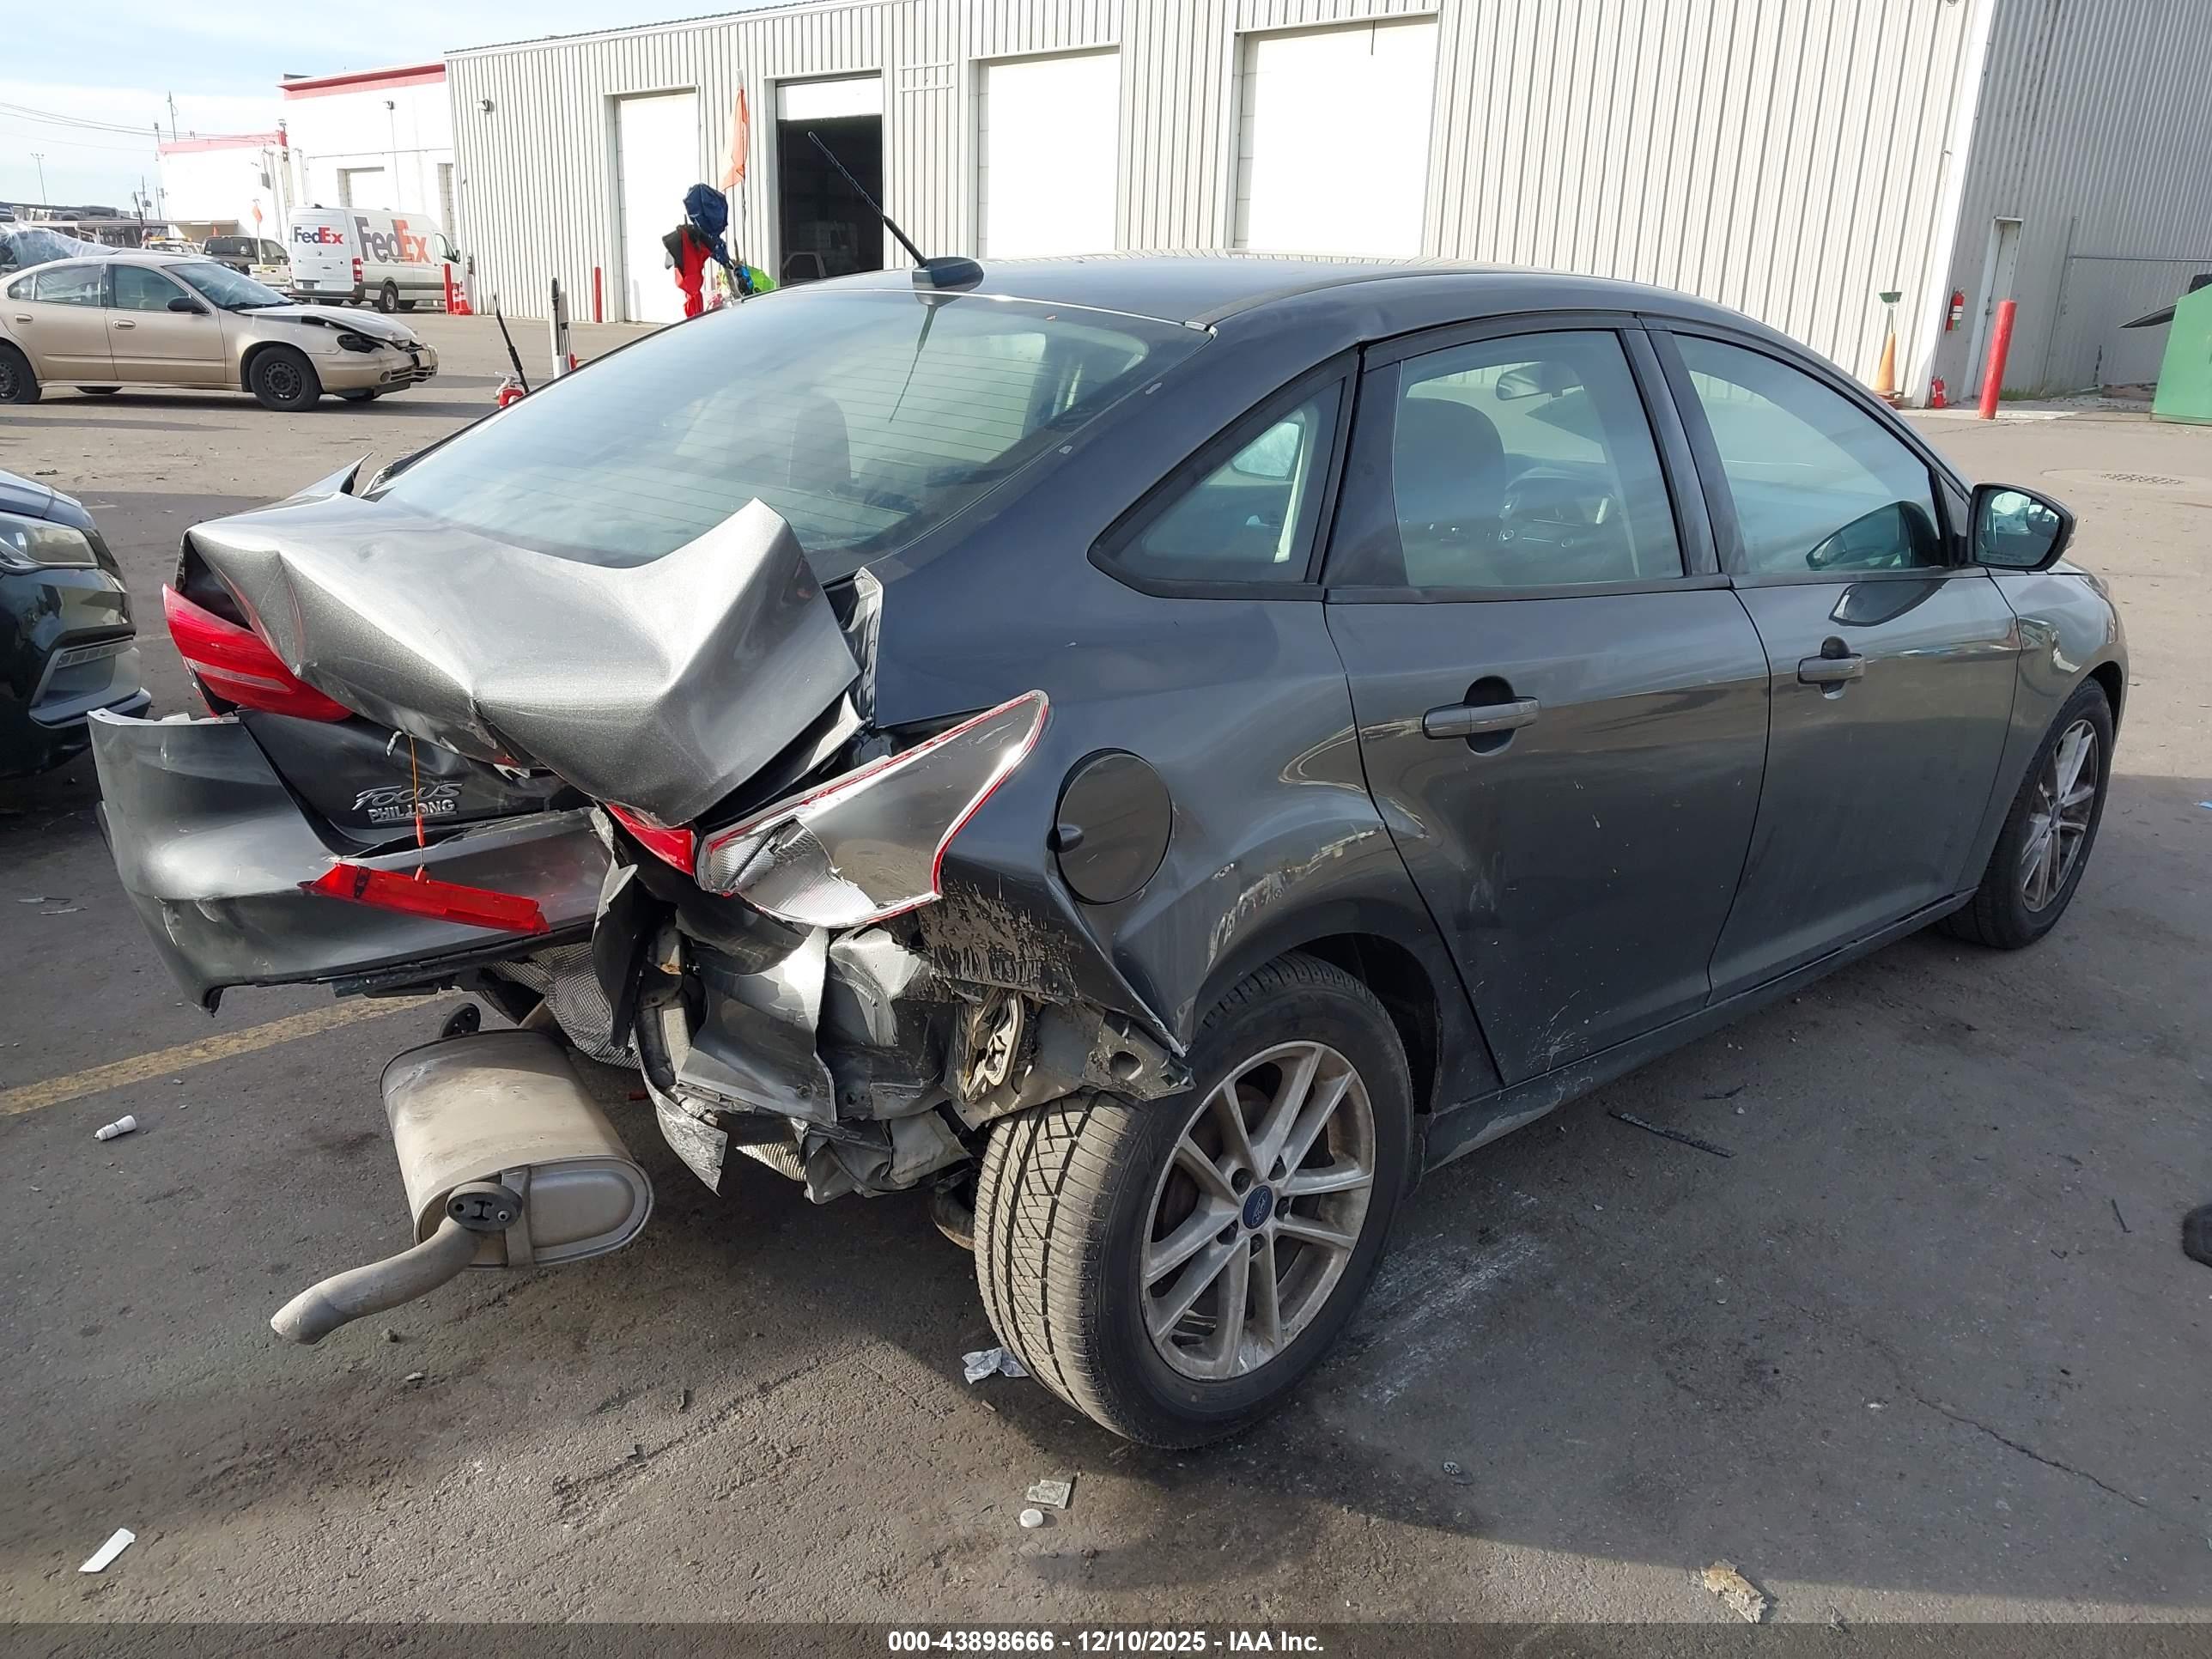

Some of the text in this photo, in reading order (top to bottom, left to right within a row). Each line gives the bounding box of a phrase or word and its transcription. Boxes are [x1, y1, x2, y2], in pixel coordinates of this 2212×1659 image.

[294, 226, 343, 245] FedEx
[354, 216, 431, 264] FedEx
[368, 805, 405, 821] PHIL
